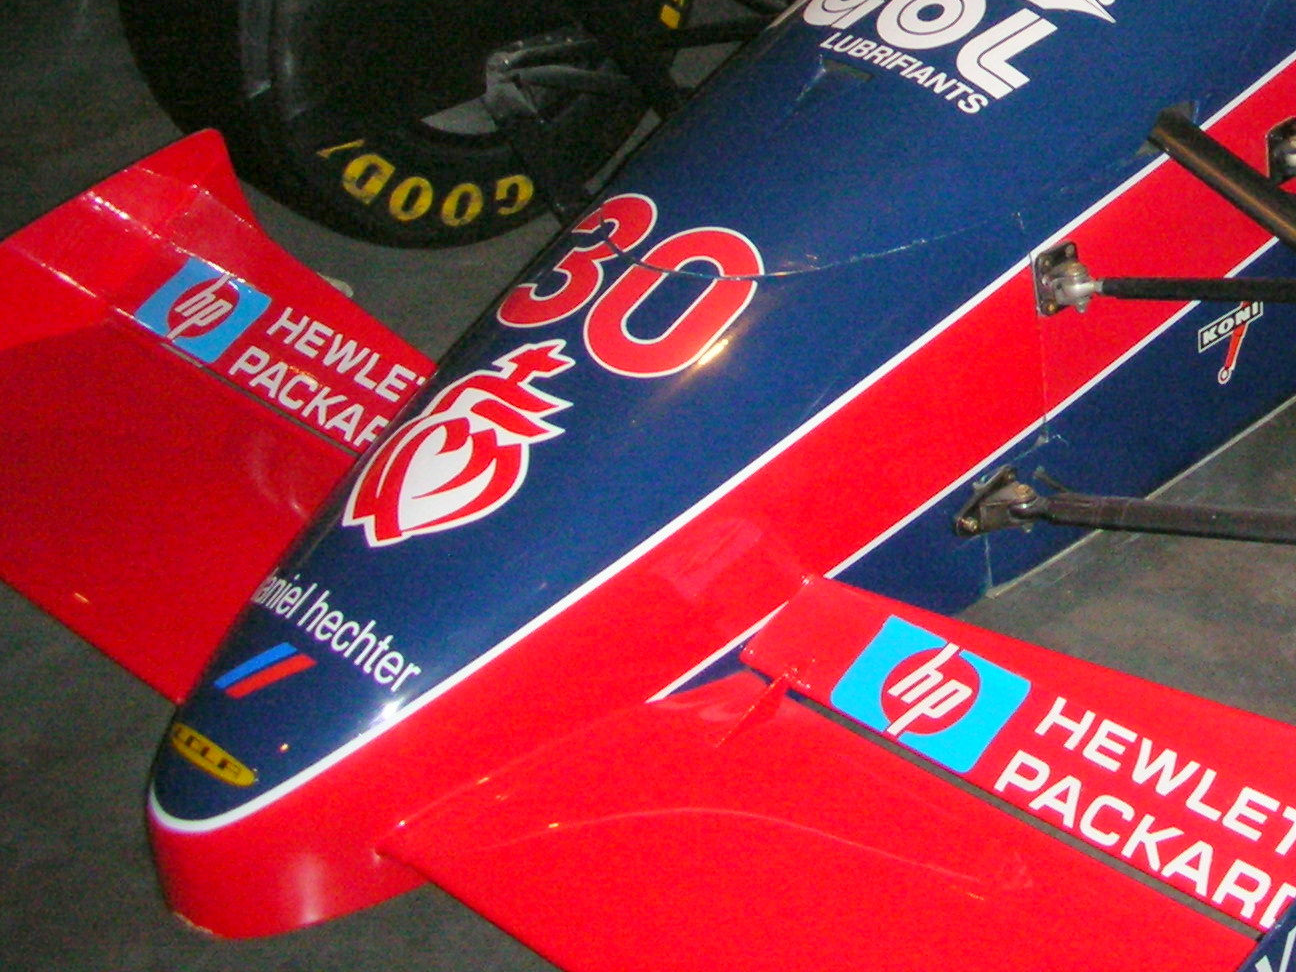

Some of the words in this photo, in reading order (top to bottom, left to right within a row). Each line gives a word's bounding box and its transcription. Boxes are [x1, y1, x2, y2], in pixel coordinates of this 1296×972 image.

[819, 31, 989, 115] LUBRIFIANTS
[166, 273, 234, 340] hp
[498, 193, 764, 378] 30
[1202, 301, 1259, 345] KONI
[266, 307, 426, 403] HEWLE
[297, 589, 422, 693] hechter
[886, 643, 976, 736] hp
